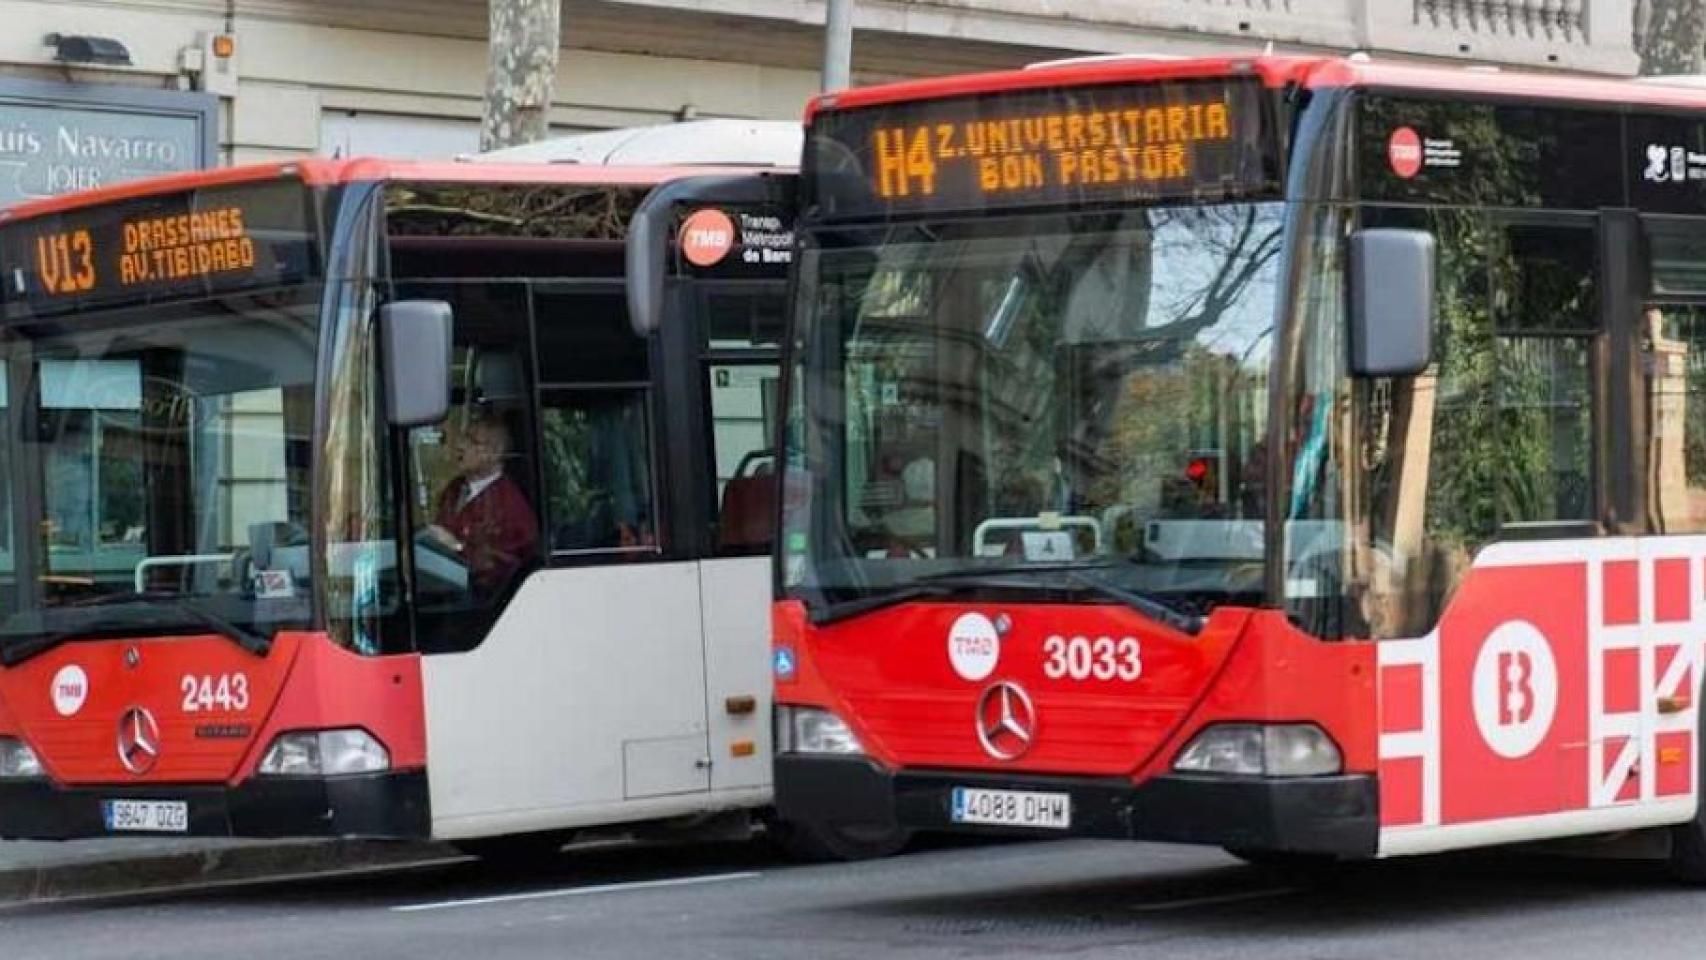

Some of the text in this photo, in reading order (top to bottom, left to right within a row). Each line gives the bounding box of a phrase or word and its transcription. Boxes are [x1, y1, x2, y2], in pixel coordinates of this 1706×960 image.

[57, 126, 175, 160] Navarro
[875, 126, 934, 196] H4
[46, 164, 101, 193] JOIER
[980, 144, 1189, 190] BON PASTOR
[123, 207, 244, 252] DRASSANES
[683, 229, 728, 249] TMB
[37, 229, 96, 294] V13
[743, 248, 760, 263] de
[1043, 635, 1142, 680] 3033
[181, 673, 249, 713] 2443
